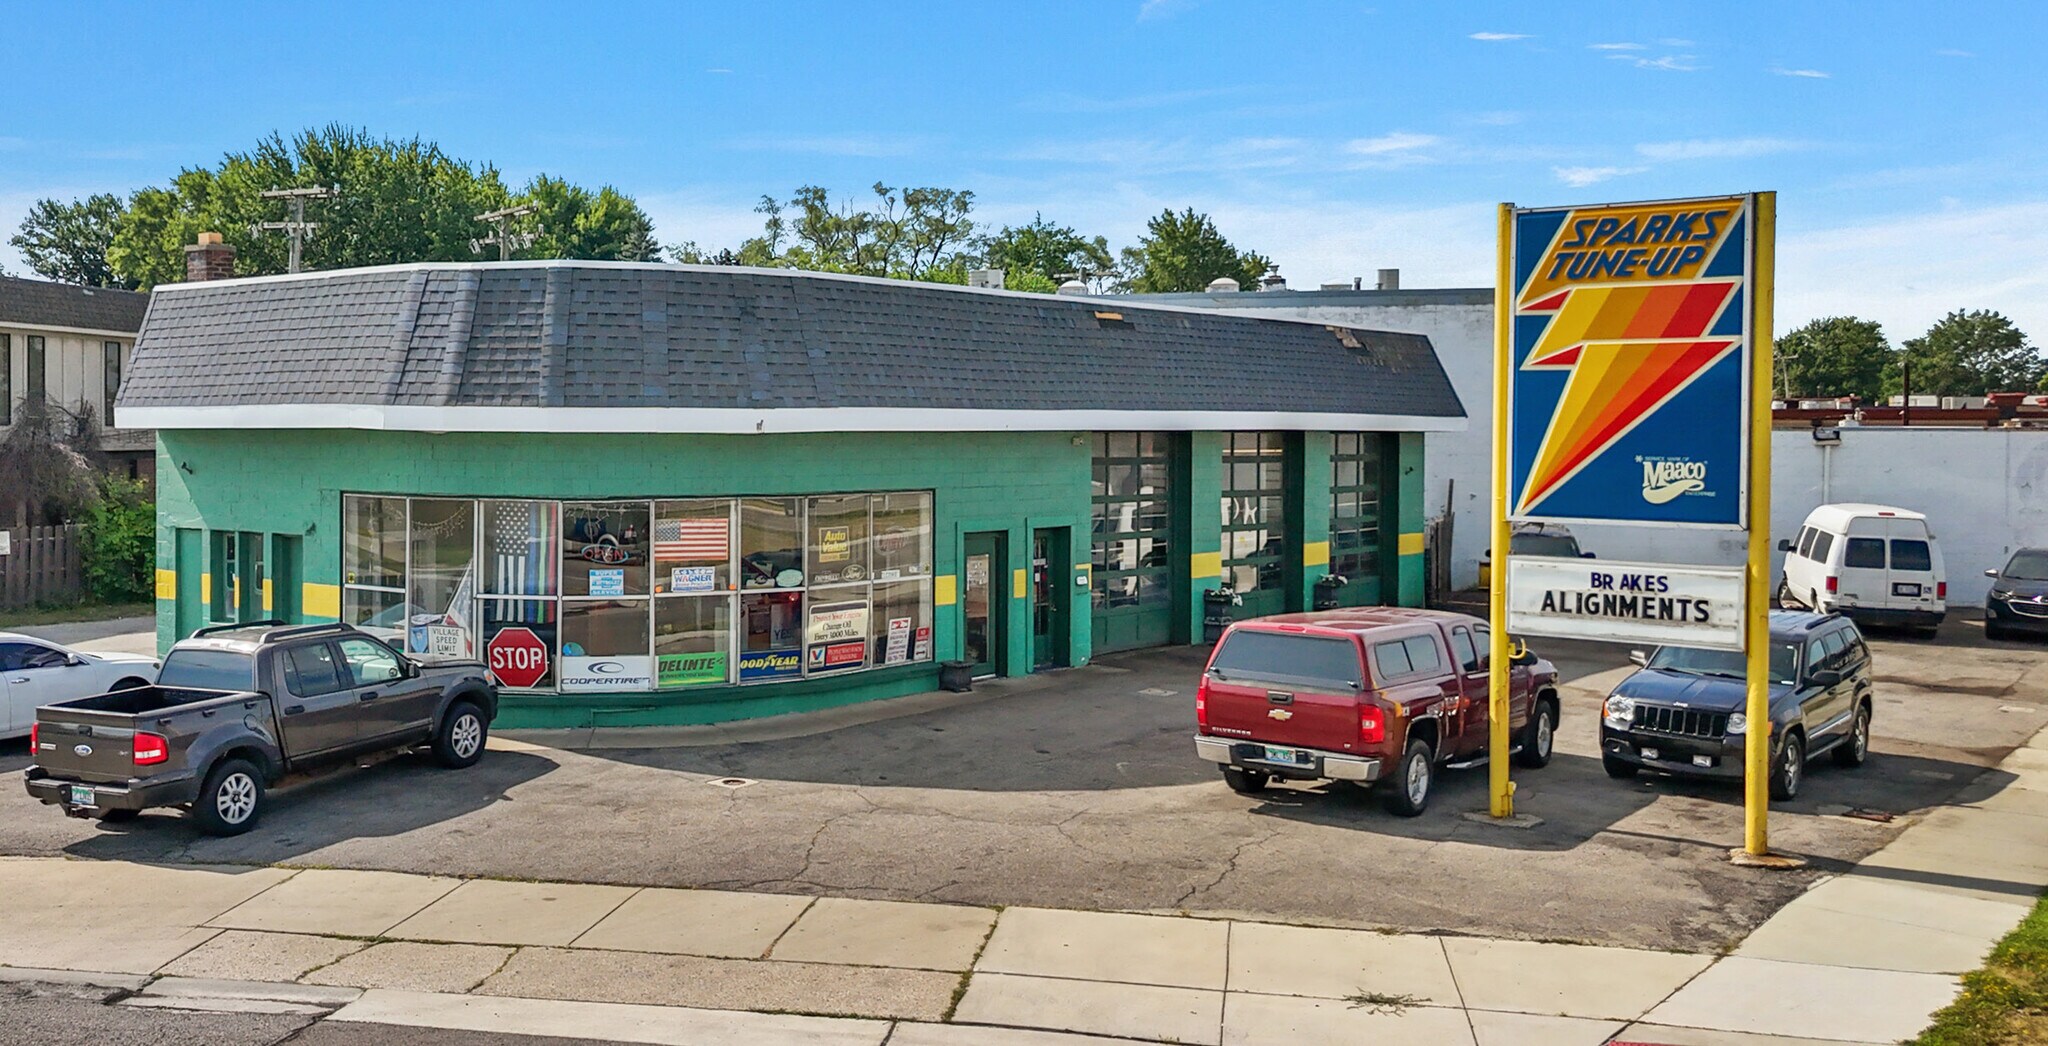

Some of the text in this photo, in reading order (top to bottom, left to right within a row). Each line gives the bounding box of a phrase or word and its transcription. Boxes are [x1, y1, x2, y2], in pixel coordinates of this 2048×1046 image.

[1560, 209, 1730, 248] SPARKS
[1546, 245, 1706, 281] TUNE-UP
[1642, 461, 1706, 488] Maaco
[824, 530, 846, 542] Auto
[822, 541, 848, 553] Value
[674, 574, 712, 582] WAGNER
[1541, 590, 1710, 623] ALIGNMENTS
[432, 628, 460, 636] VILLAGE
[823, 621, 852, 631] Change Oil
[436, 636, 458, 644] SPEED
[814, 632, 829, 641] Every
[844, 629, 859, 637] Miles
[437, 644, 456, 652] LIMIT
[492, 646, 543, 670] STOP
[659, 657, 716, 672] DELINTE
